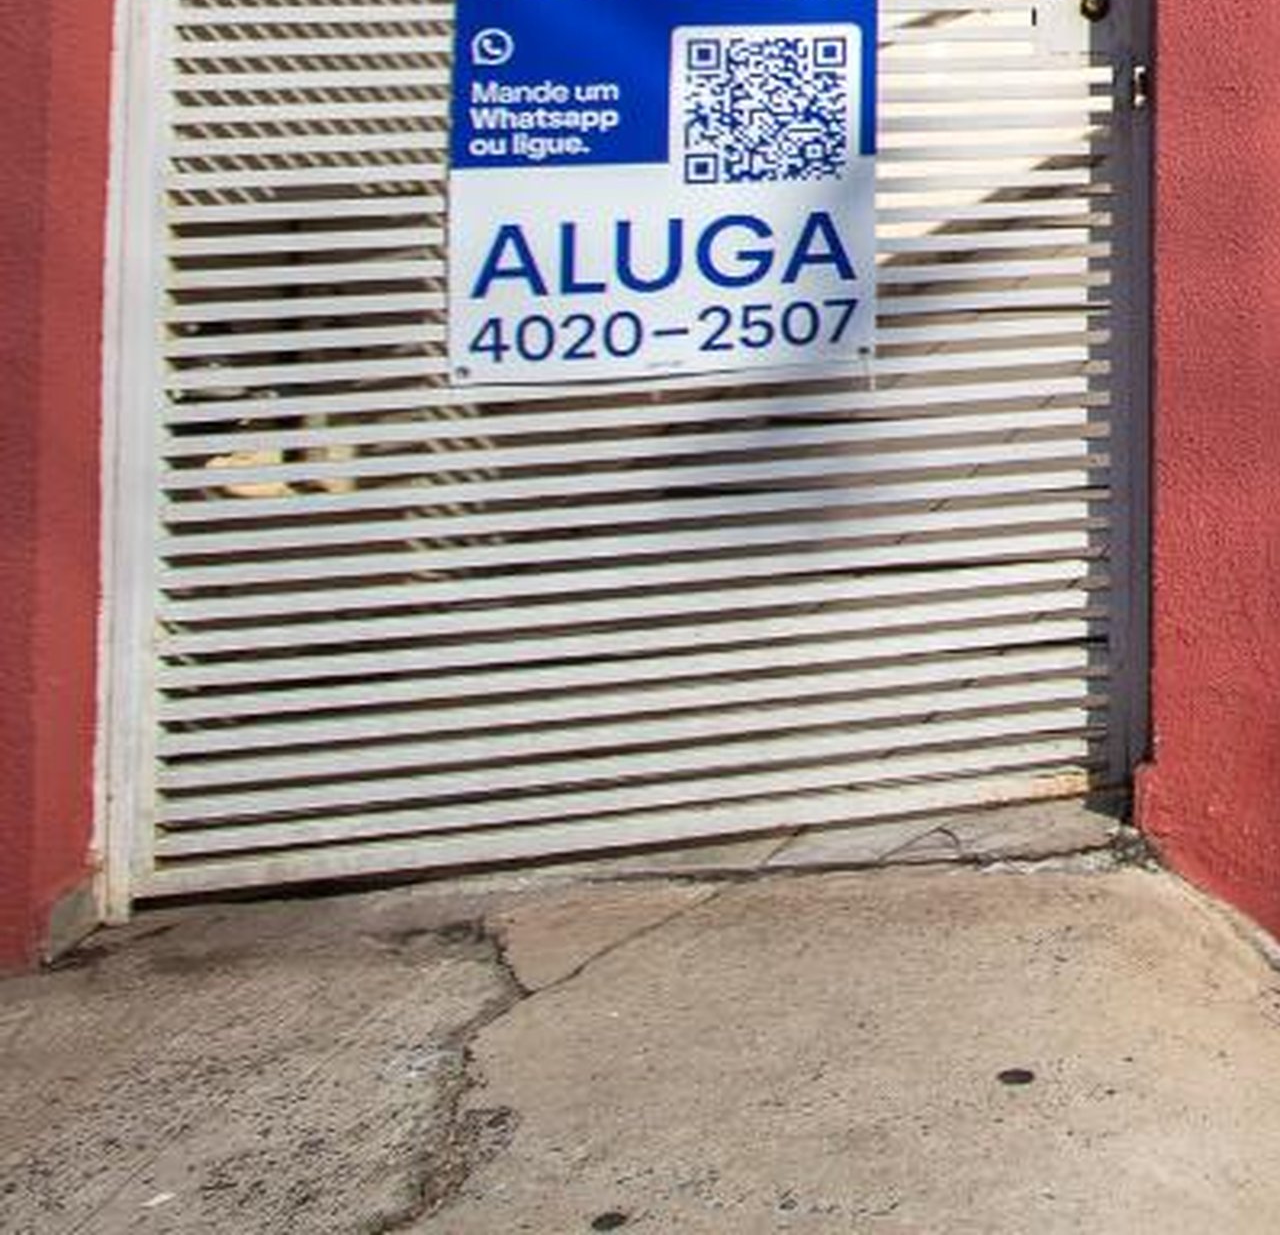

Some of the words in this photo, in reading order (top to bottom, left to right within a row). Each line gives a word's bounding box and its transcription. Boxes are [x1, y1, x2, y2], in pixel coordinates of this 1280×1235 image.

[471, 80, 569, 103] Mande
[575, 83, 619, 101] um
[469, 107, 619, 132] Whatsapp
[469, 137, 507, 156] ou
[512, 133, 591, 160] ligue.
[470, 211, 858, 299] ALUGA
[468, 298, 859, 363] 4020-2507
